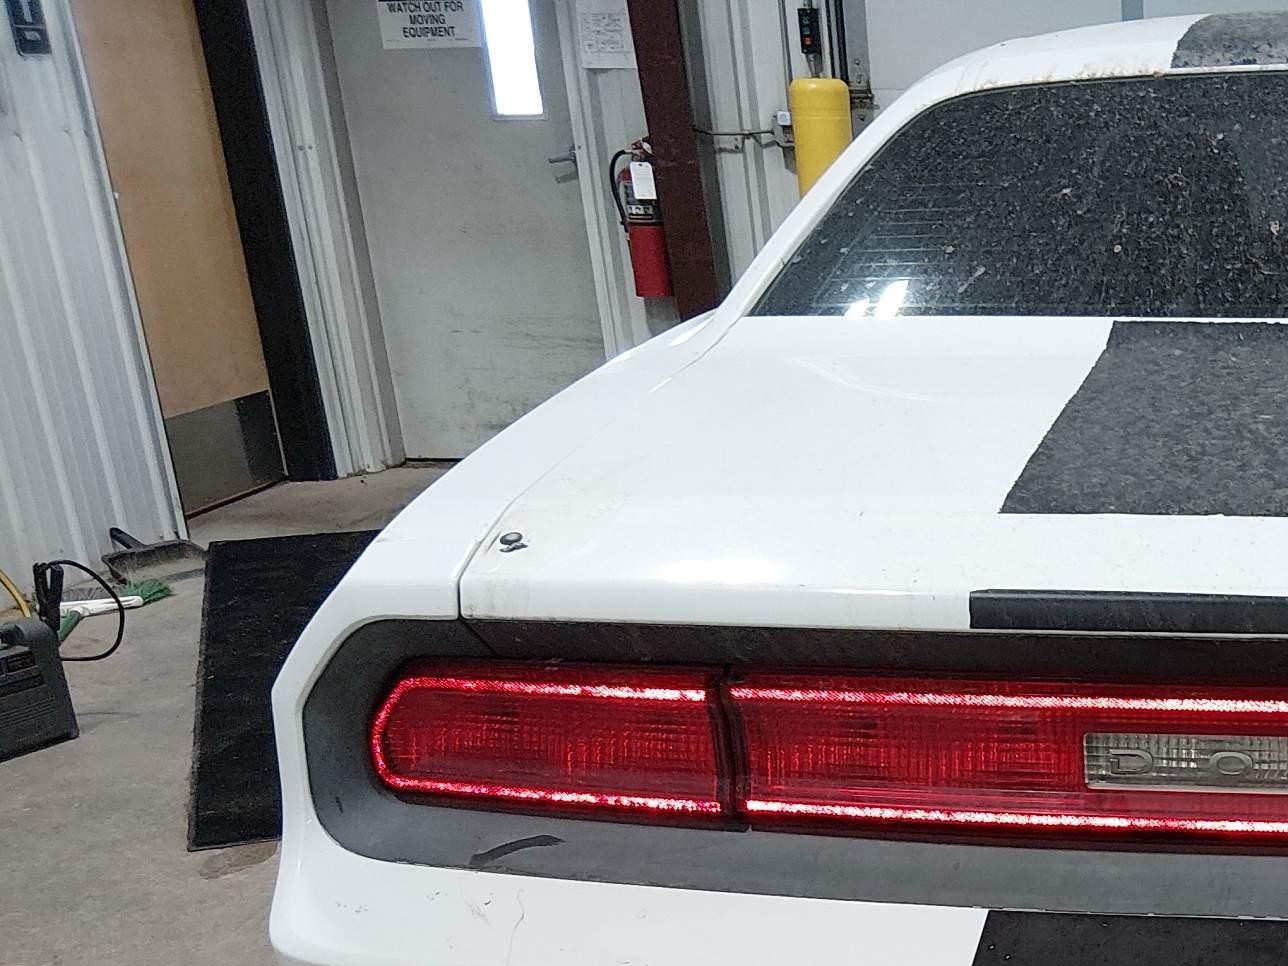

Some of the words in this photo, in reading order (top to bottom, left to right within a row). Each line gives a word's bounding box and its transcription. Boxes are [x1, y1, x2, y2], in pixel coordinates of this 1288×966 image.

[387, 2, 420, 13] WATCH
[422, 1, 441, 13] OUT
[444, 1, 464, 12] FOR
[409, 14, 446, 25] MOVING
[402, 26, 455, 38] EQUIPMENT
